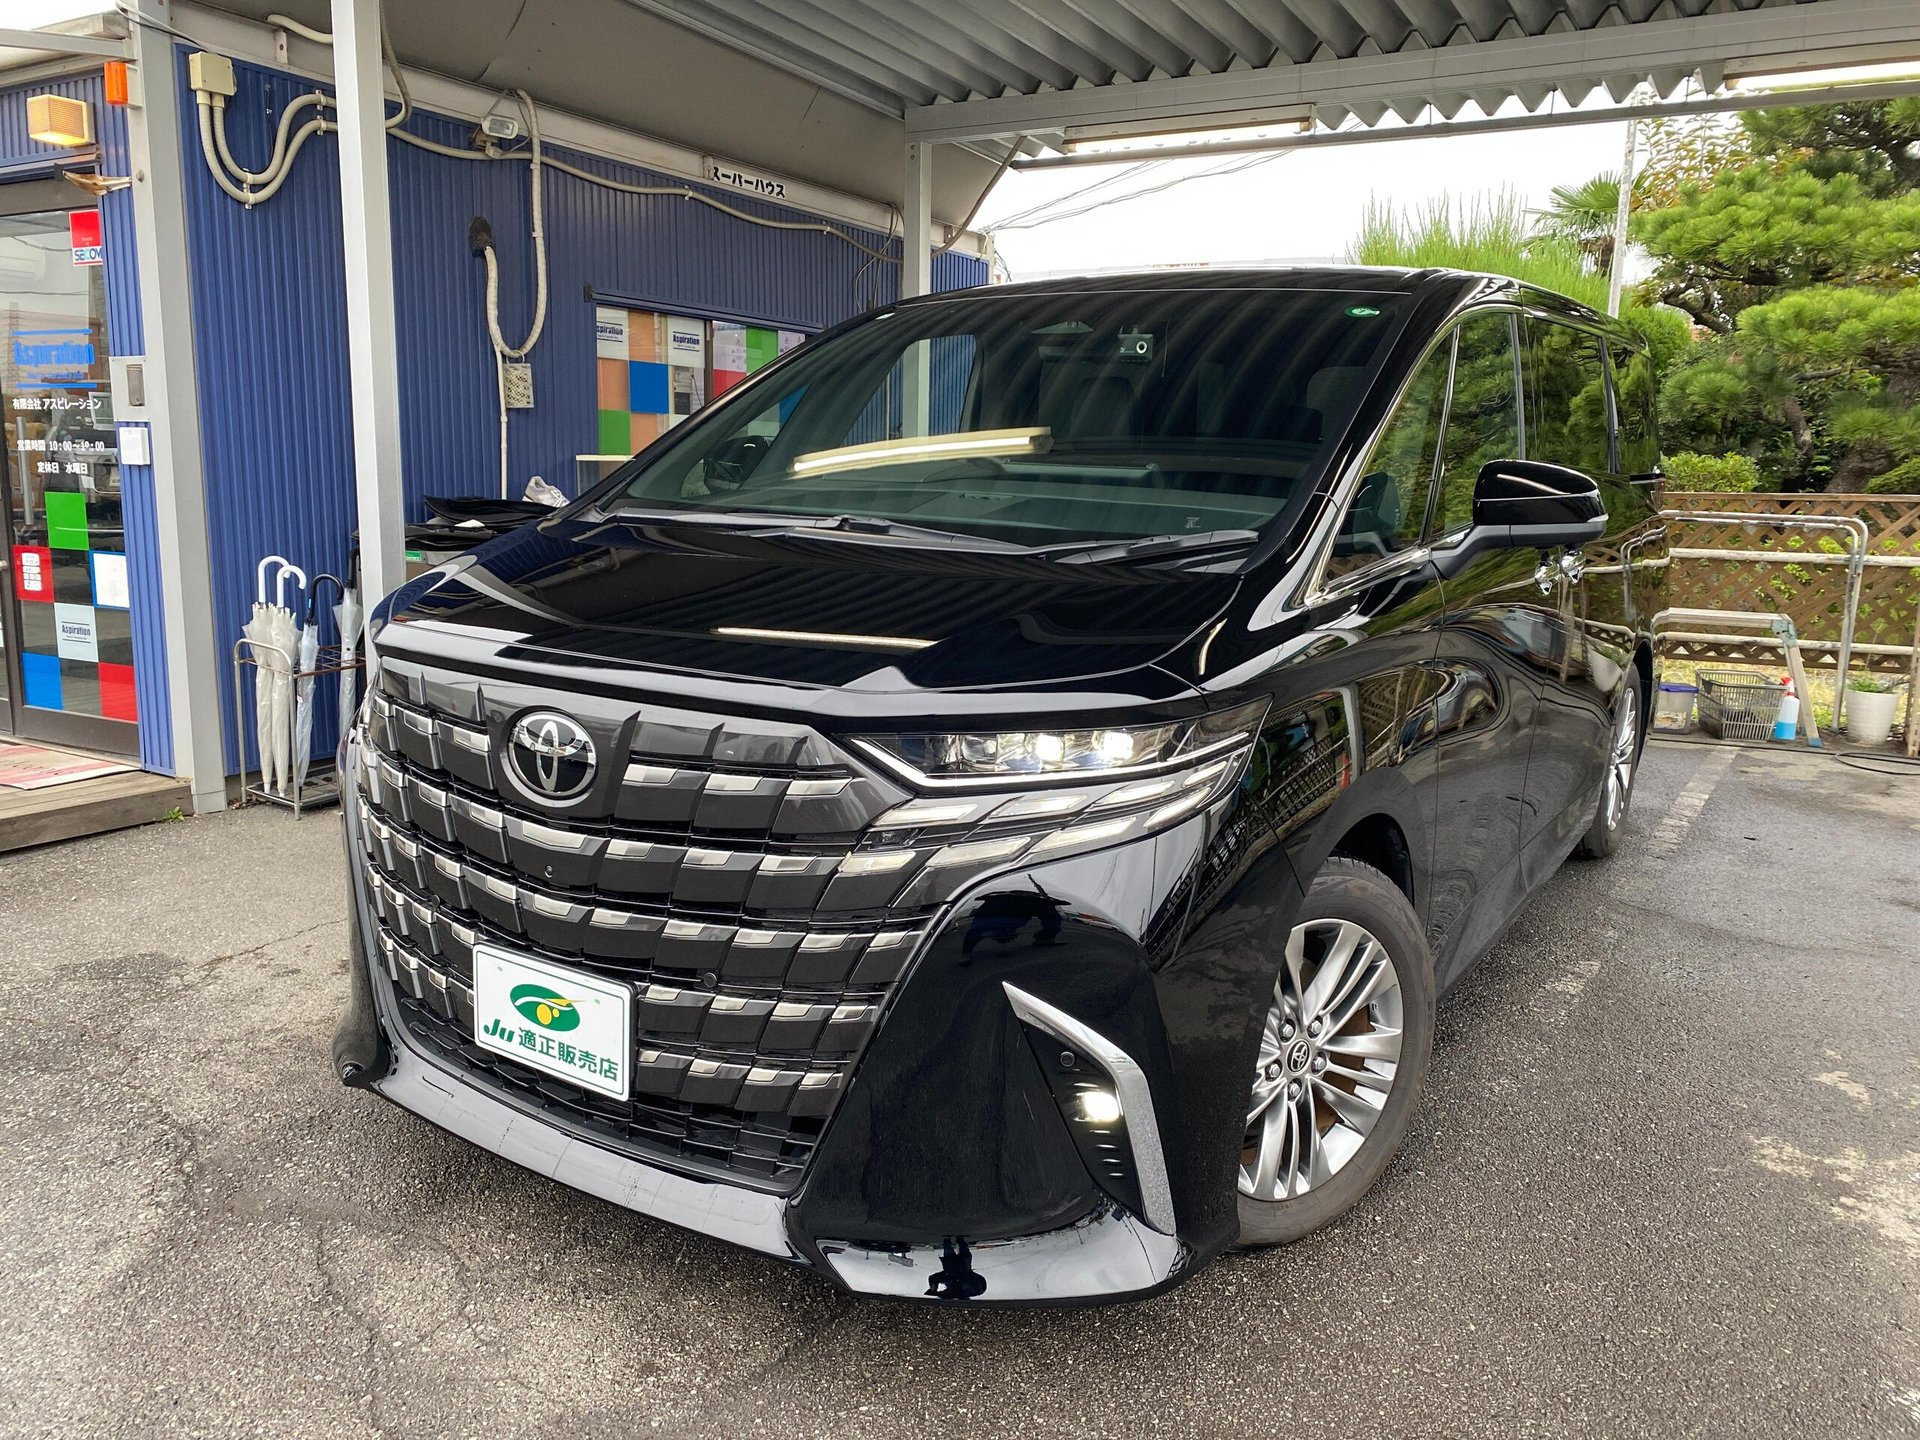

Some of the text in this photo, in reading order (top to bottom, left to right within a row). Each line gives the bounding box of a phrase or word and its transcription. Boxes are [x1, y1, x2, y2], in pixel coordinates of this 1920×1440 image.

[596, 325, 623, 336] spiration
[672, 334, 700, 345] Aspiration
[62, 624, 91, 636] Aspiration
[518, 1026, 619, 1082] 適正販売店
